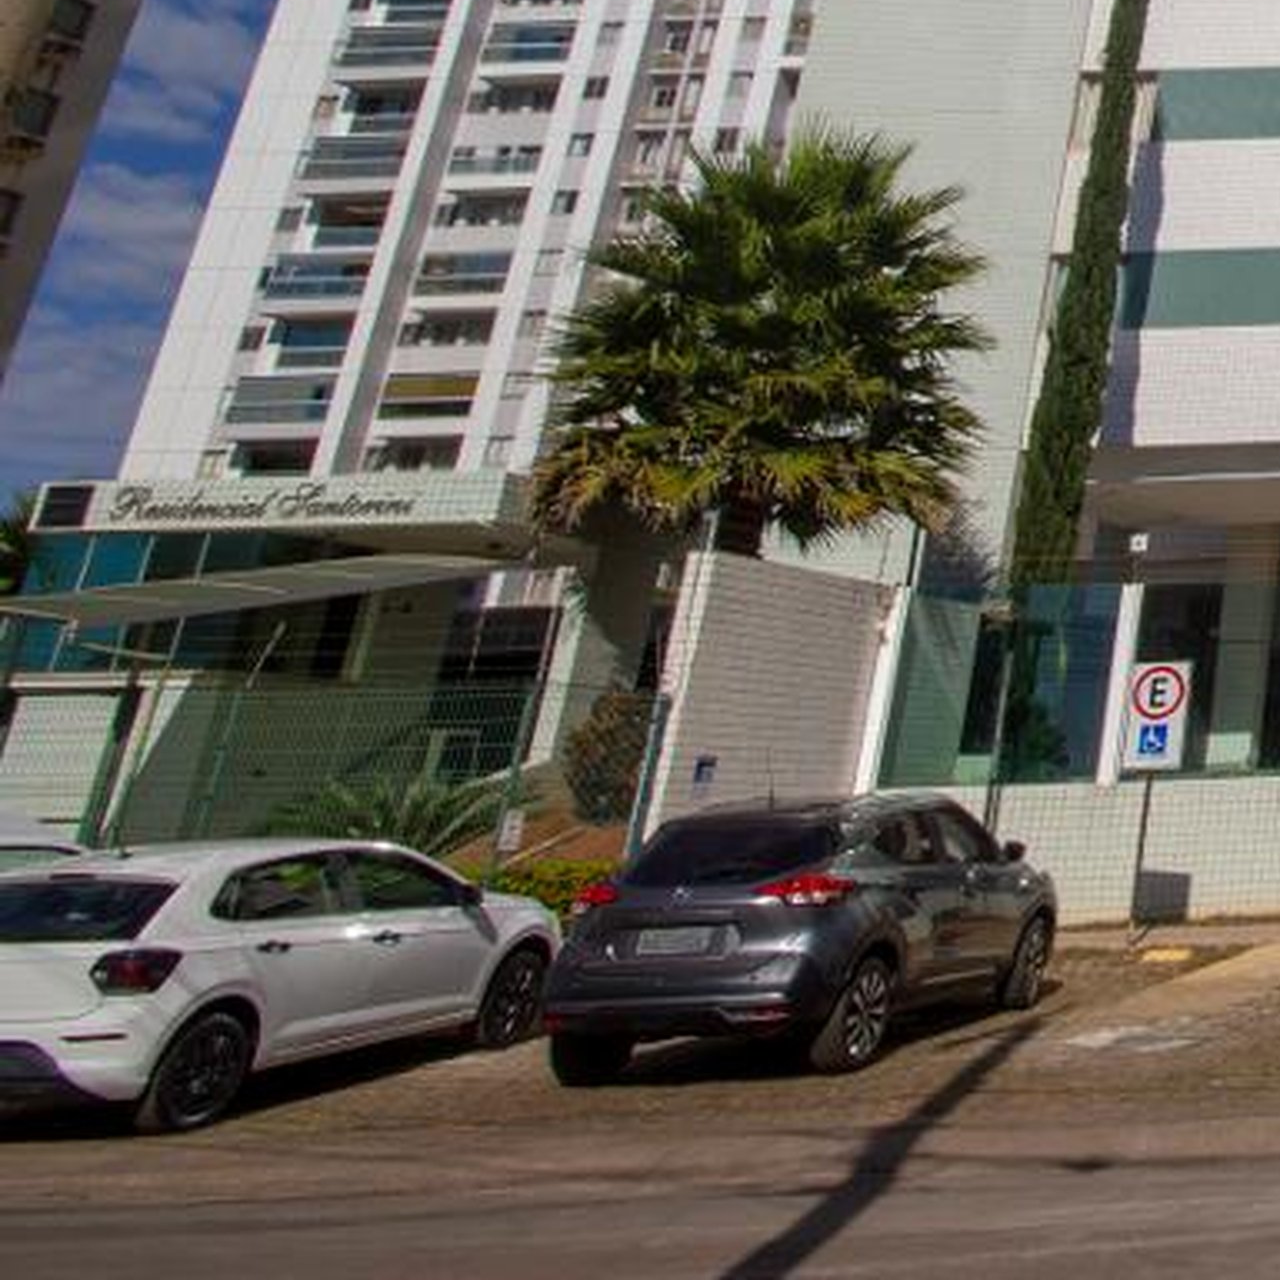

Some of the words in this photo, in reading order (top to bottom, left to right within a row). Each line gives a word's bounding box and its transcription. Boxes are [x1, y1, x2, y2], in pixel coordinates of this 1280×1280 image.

[109, 486, 278, 521] Residencial
[276, 482, 416, 518] Santorini
[1149, 676, 1170, 709] E
